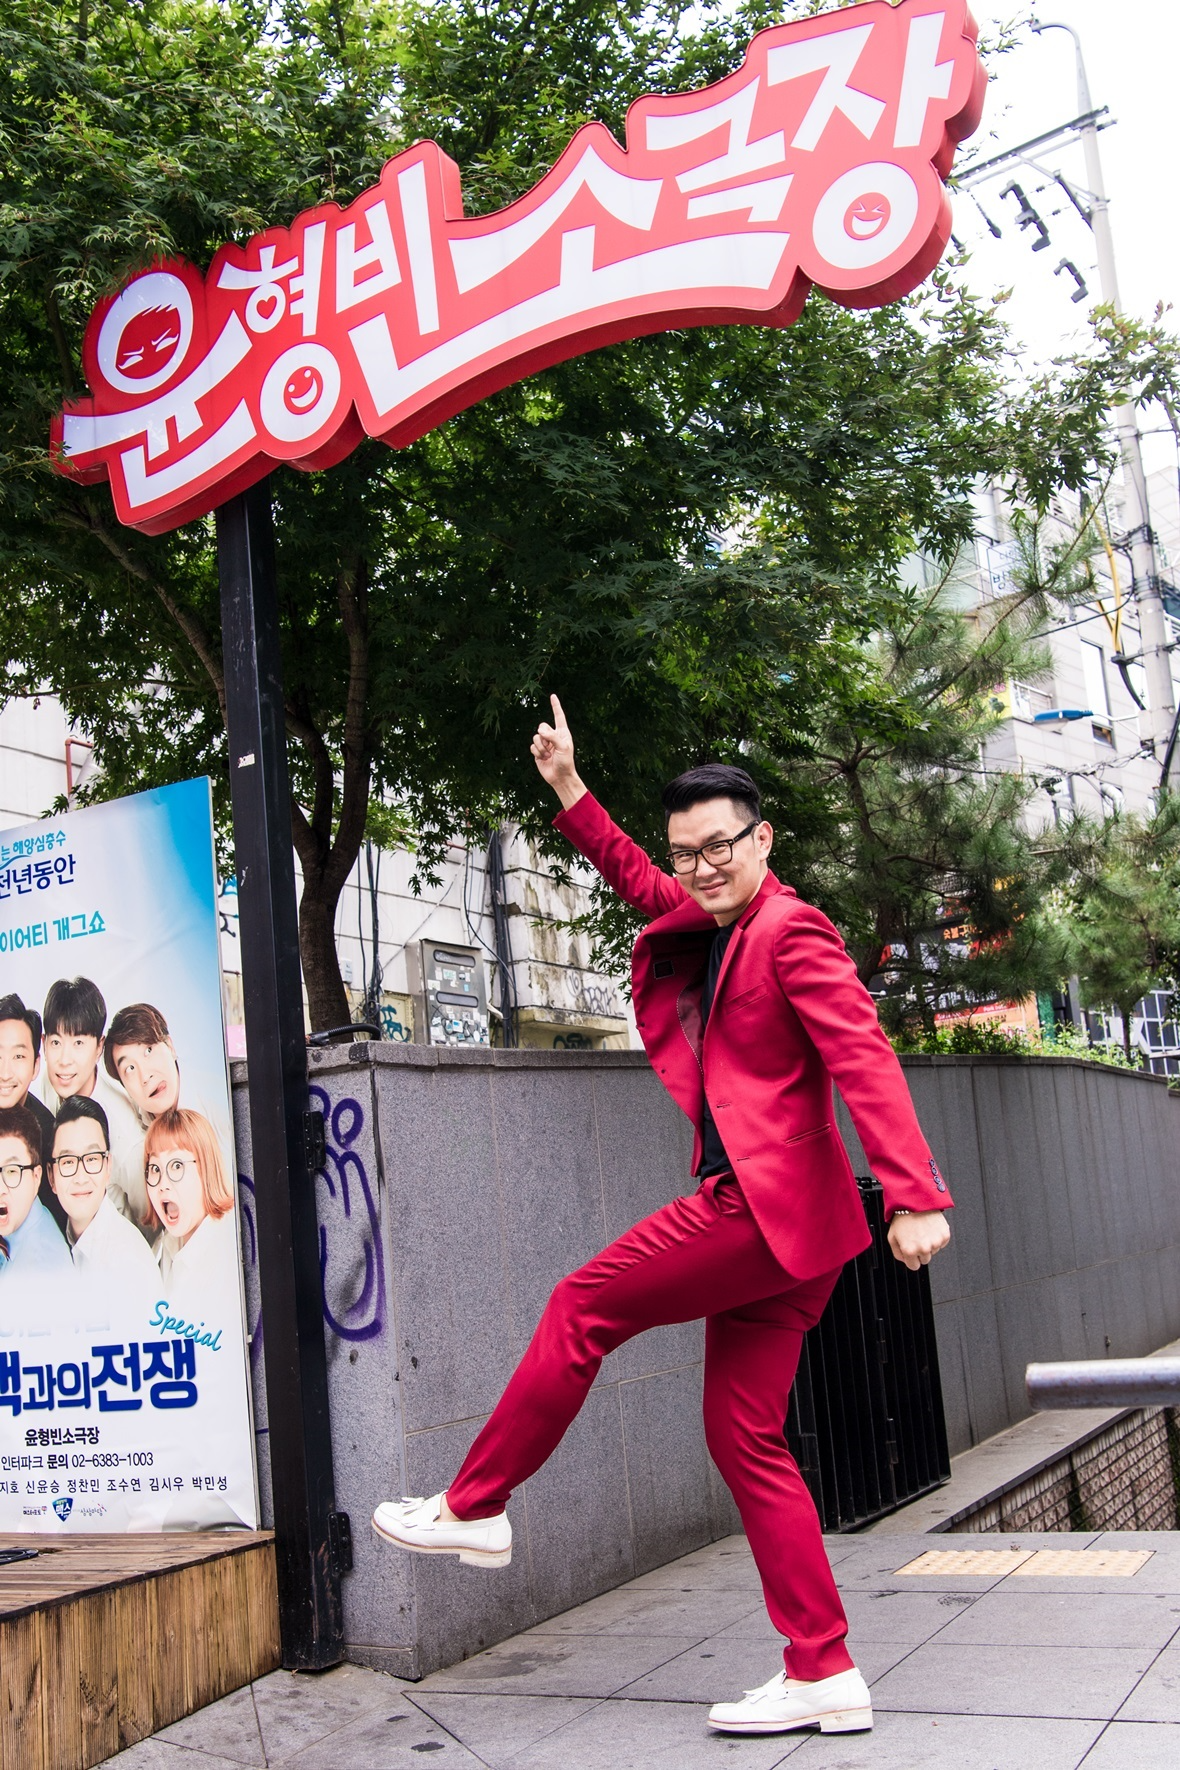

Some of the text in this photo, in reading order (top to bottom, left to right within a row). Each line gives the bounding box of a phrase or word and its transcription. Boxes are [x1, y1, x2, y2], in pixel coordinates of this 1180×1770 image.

[62, 11, 957, 508] 윤형빈소극장
[13, 830, 66, 855] 해양심층수
[53, 911, 106, 941] 개그쇼
[149, 1300, 223, 1351] Special
[25, 1427, 100, 1446] 윤형빈소극장
[1, 1452, 154, 1471] 인터파크 문의 02-6383-1003
[25, 1479, 60, 1494] 신윤승
[67, 1478, 100, 1493] 정찬민
[107, 1477, 142, 1492] 조수연
[149, 1477, 184, 1492] 김시우
[192, 1475, 228, 1492] 박민성
